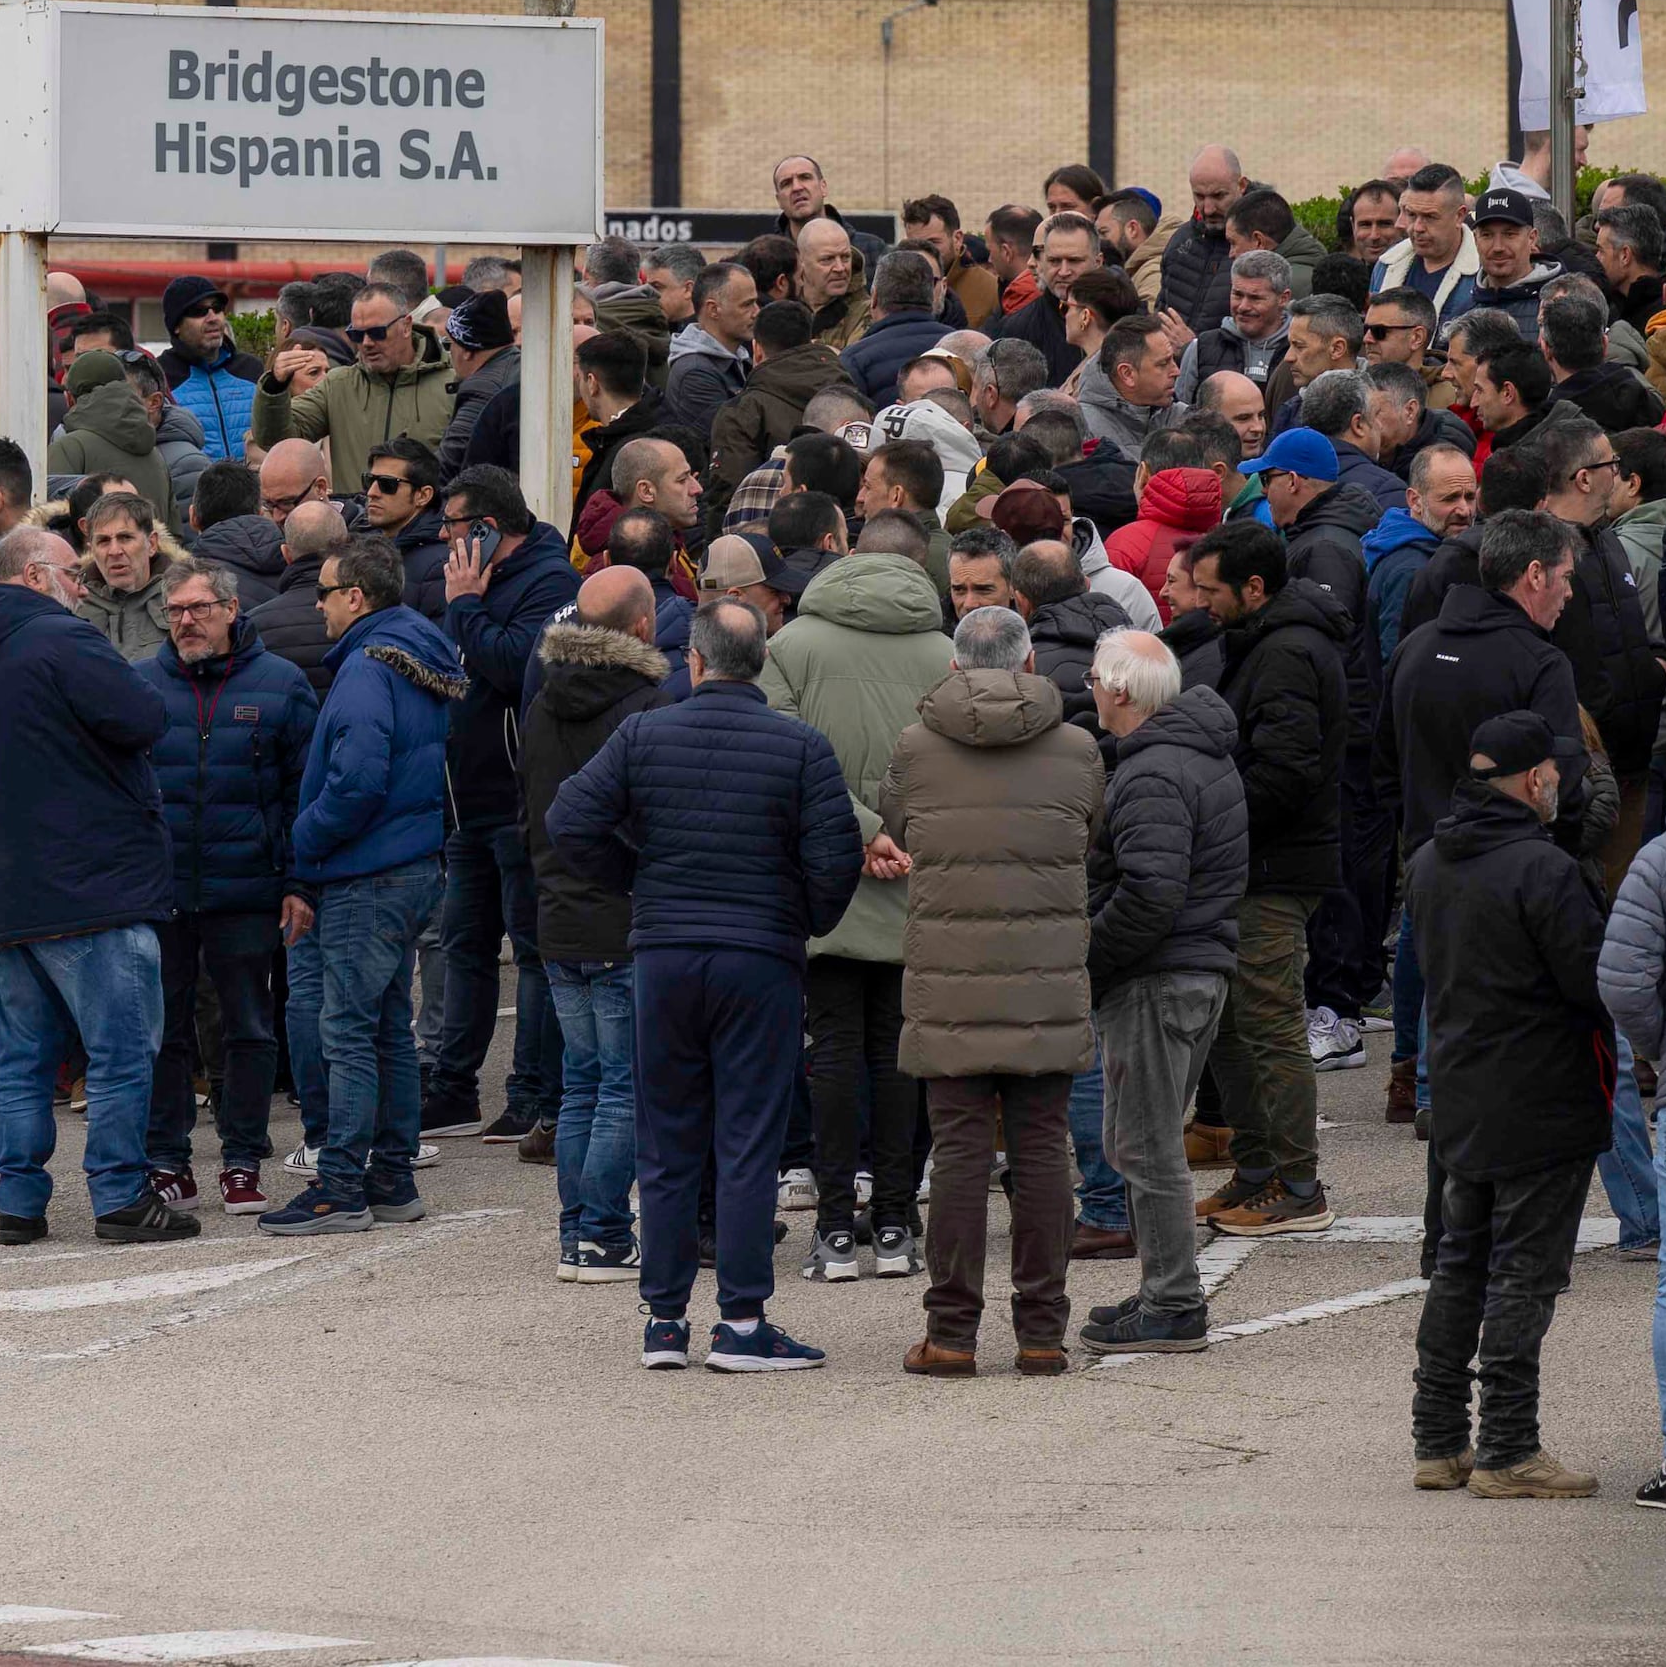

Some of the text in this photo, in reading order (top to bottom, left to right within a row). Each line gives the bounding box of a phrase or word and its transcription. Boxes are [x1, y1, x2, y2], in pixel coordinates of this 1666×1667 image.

[167, 48, 486, 117] Bridgestone
[154, 121, 499, 188] Hispania S.A.
[605, 215, 693, 241] nados
